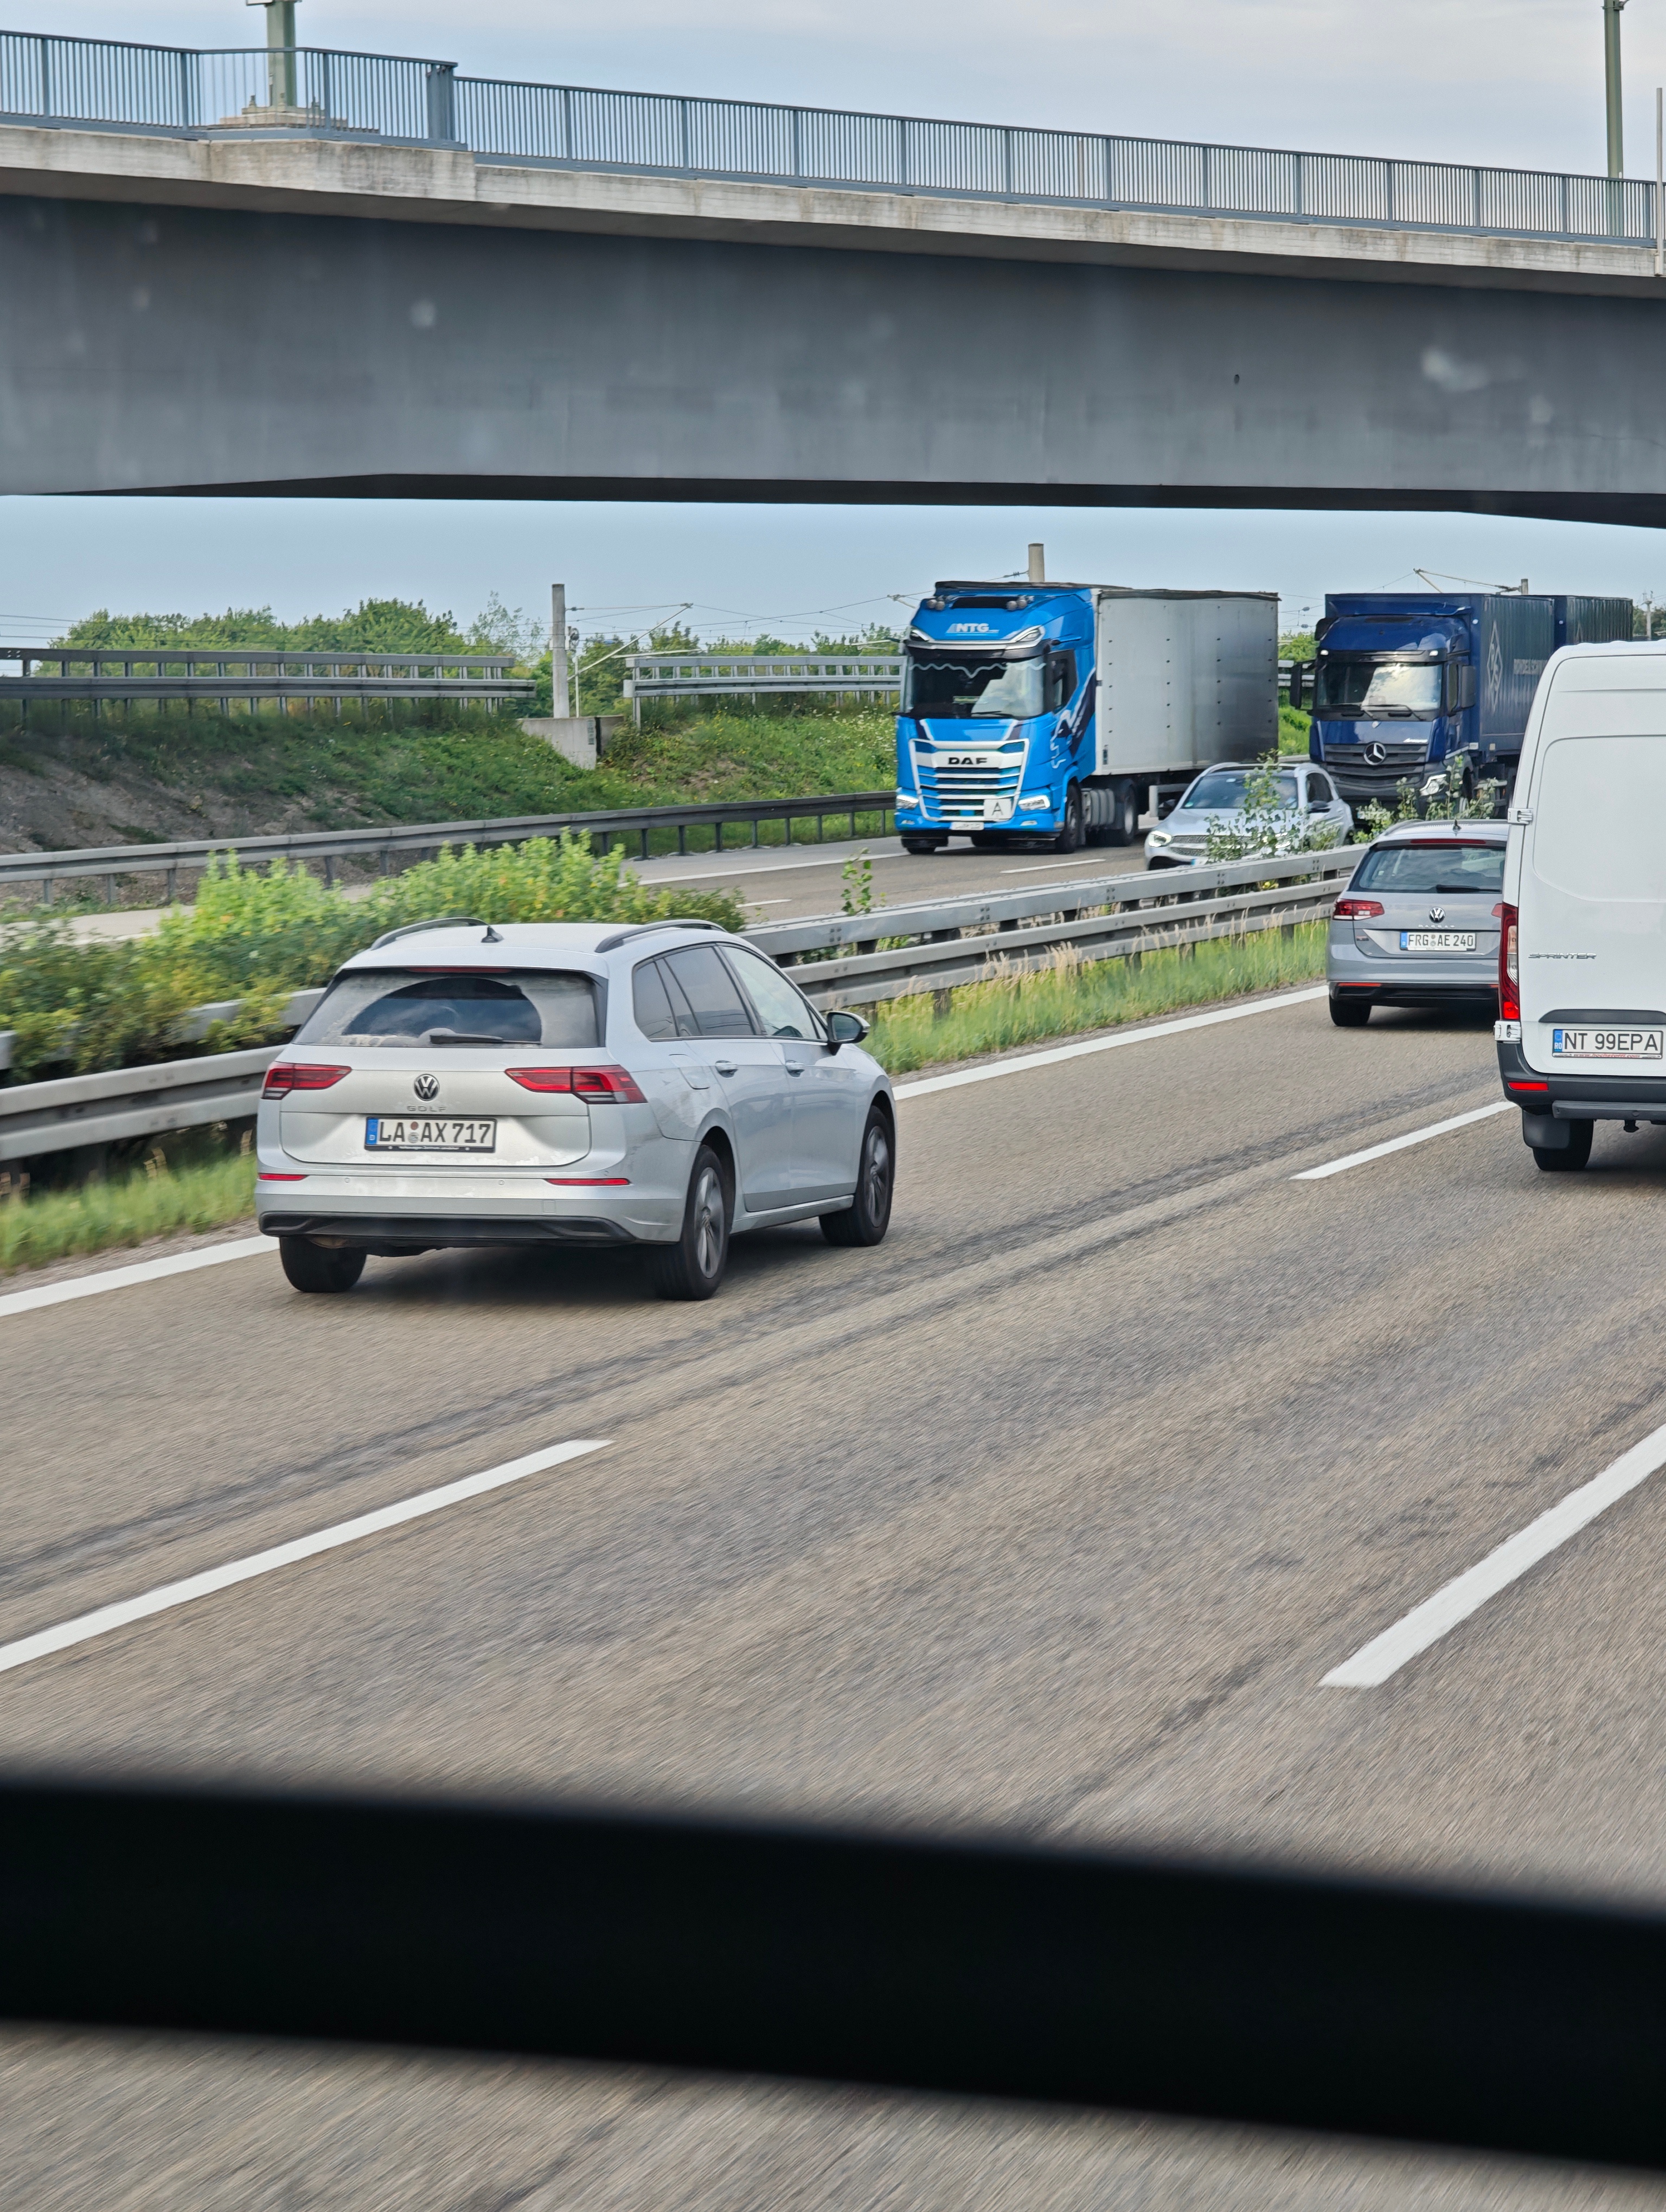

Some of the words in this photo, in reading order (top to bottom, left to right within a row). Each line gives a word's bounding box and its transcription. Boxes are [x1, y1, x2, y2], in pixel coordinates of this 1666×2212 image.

[956, 623, 990, 633] NTG
[991, 802, 1003, 815] A
[1408, 934, 1428, 946] FRG
[1437, 935, 1451, 947] AE
[1453, 935, 1473, 947] 240
[1554, 1042, 1562, 1050] RO
[1565, 1032, 1588, 1050] NT
[1595, 1033, 1658, 1051] 99EPA
[379, 1121, 405, 1142] LA
[420, 1122, 447, 1143] AX
[452, 1123, 492, 1143] 717
